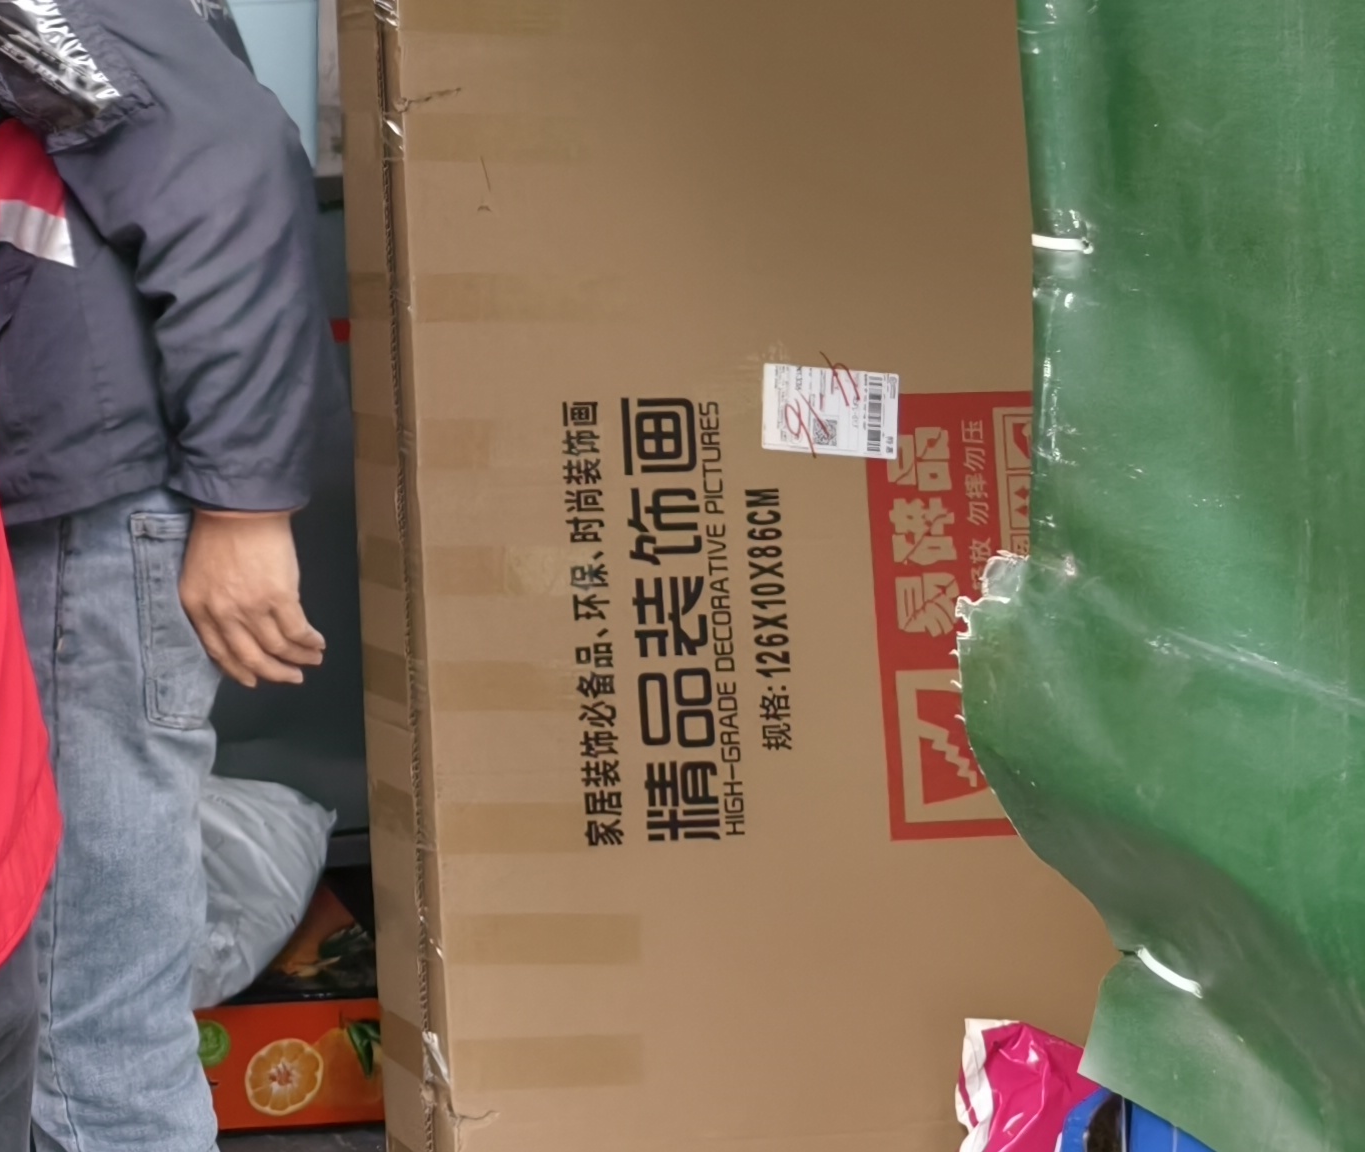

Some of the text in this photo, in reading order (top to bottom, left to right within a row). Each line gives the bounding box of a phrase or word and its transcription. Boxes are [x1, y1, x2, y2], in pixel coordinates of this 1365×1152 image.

[562, 401, 624, 846] 家居装饰必备品、环保、时尚装饰画
[620, 397, 721, 841] 精品装饰画
[698, 401, 746, 836] HIGH-GRADE DECORATIVE PICTURES
[887, 426, 960, 638] 易碎品
